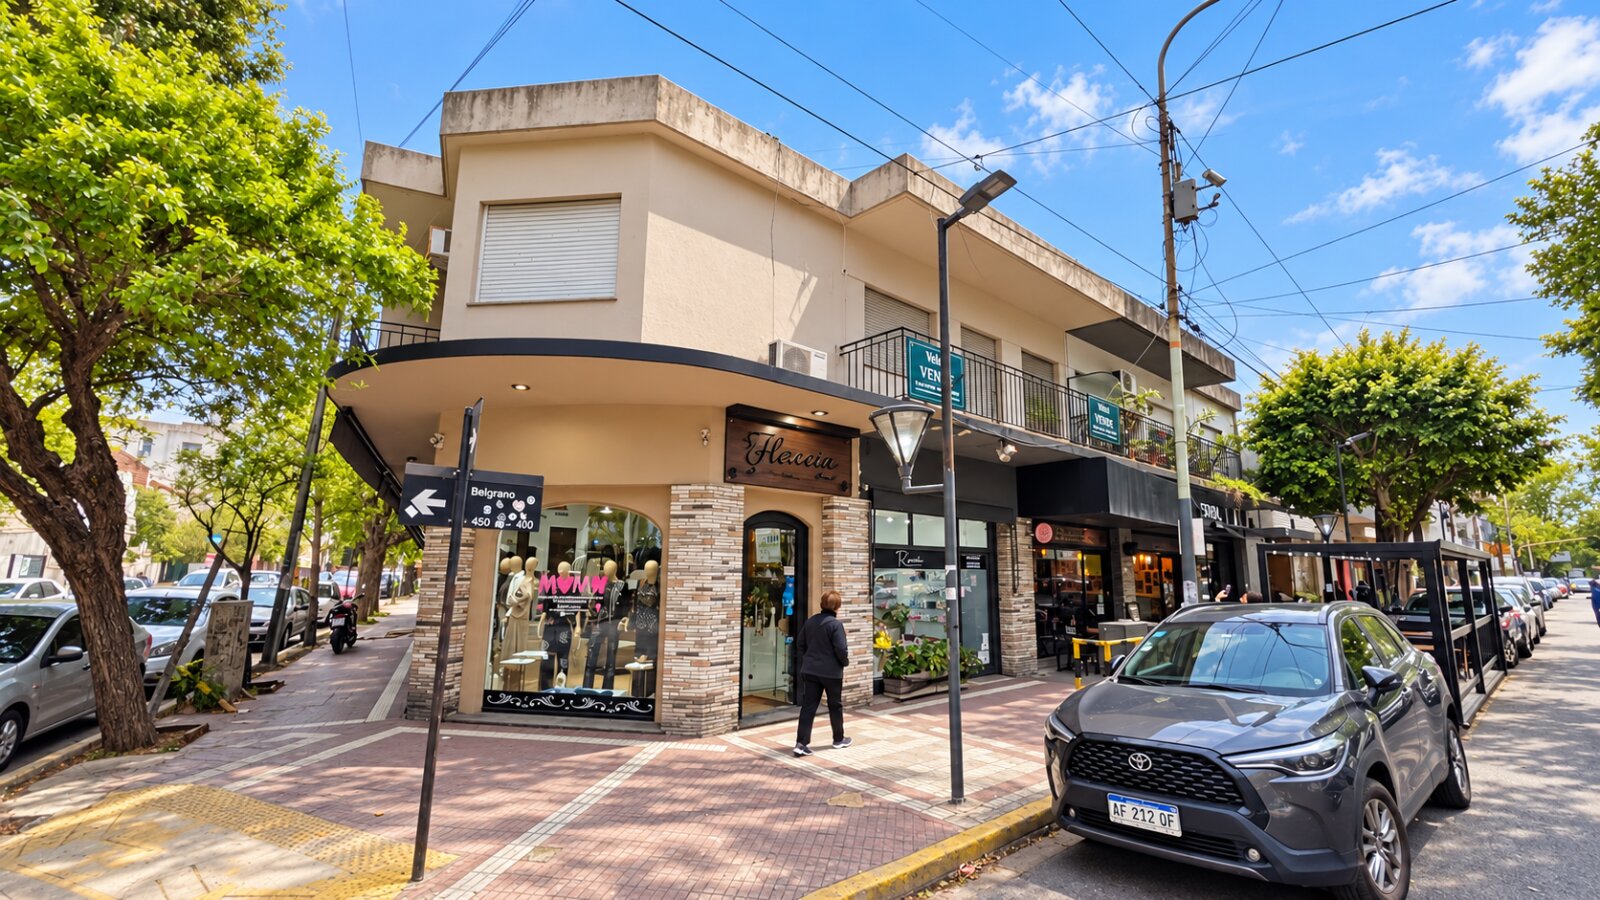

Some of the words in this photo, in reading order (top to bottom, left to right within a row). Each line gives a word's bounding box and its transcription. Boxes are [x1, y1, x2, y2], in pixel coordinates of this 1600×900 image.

[471, 486, 516, 500] Belgrano
[471, 516, 491, 527] 450
[516, 519, 534, 530] 400
[1113, 802, 1127, 818] AF
[1131, 806, 1156, 824] 212
